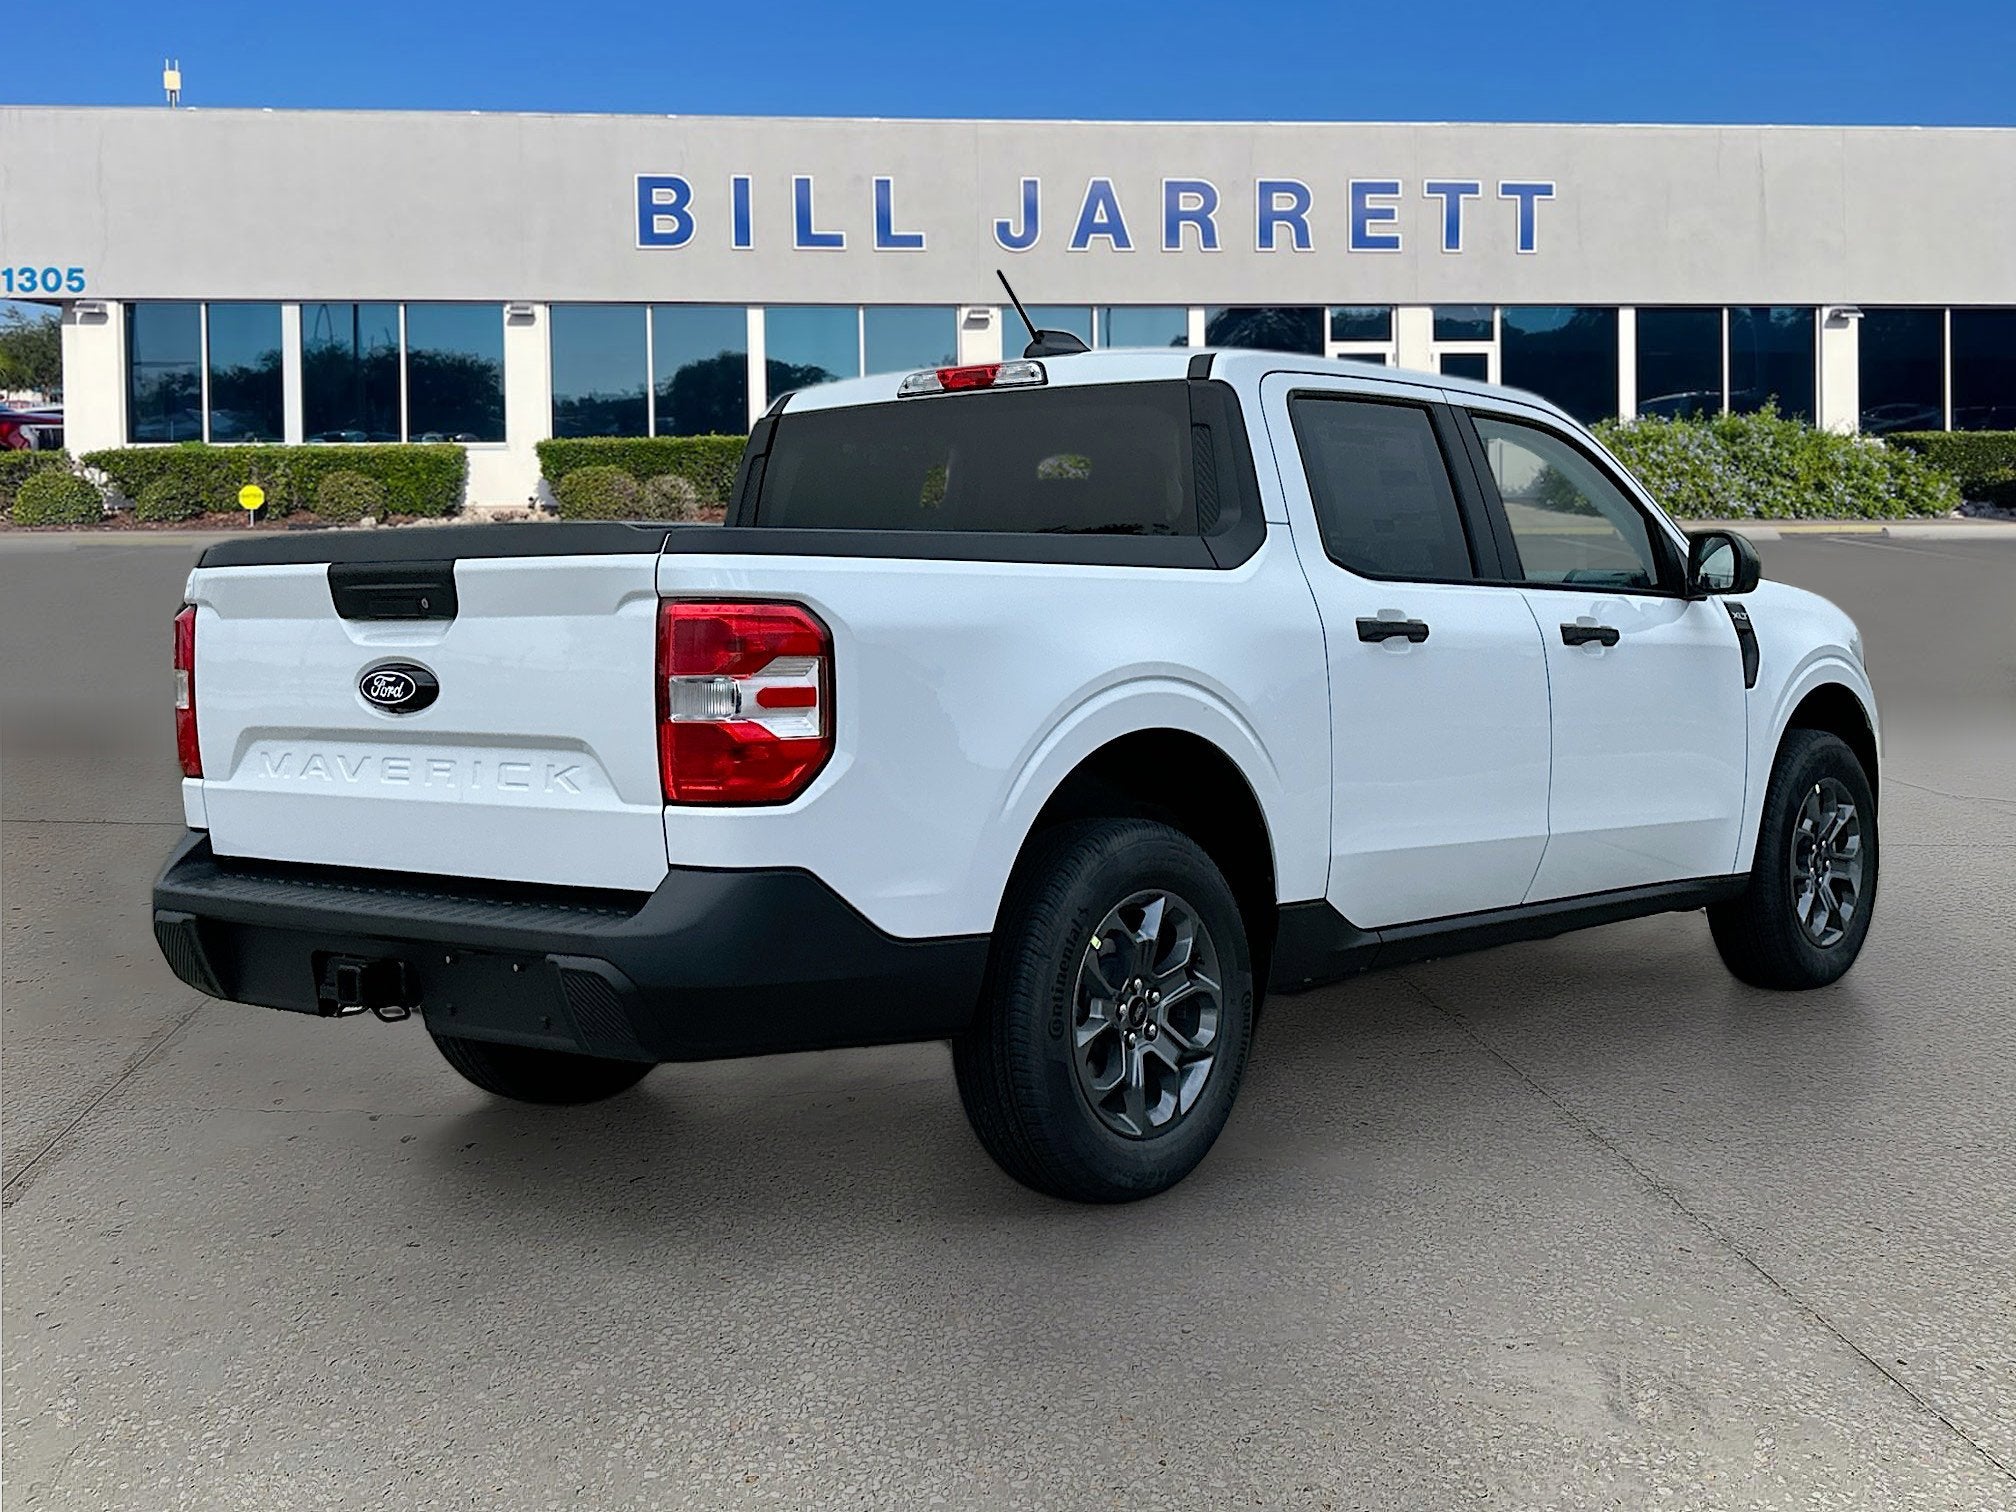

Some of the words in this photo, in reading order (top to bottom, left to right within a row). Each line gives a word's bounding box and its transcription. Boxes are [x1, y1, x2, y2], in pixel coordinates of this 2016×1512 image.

[635, 173, 926, 252] BILL
[992, 177, 1556, 255] JARRETT
[1, 267, 86, 293] 1305
[371, 675, 404, 698] Ford
[258, 751, 581, 794] MAVERICK
